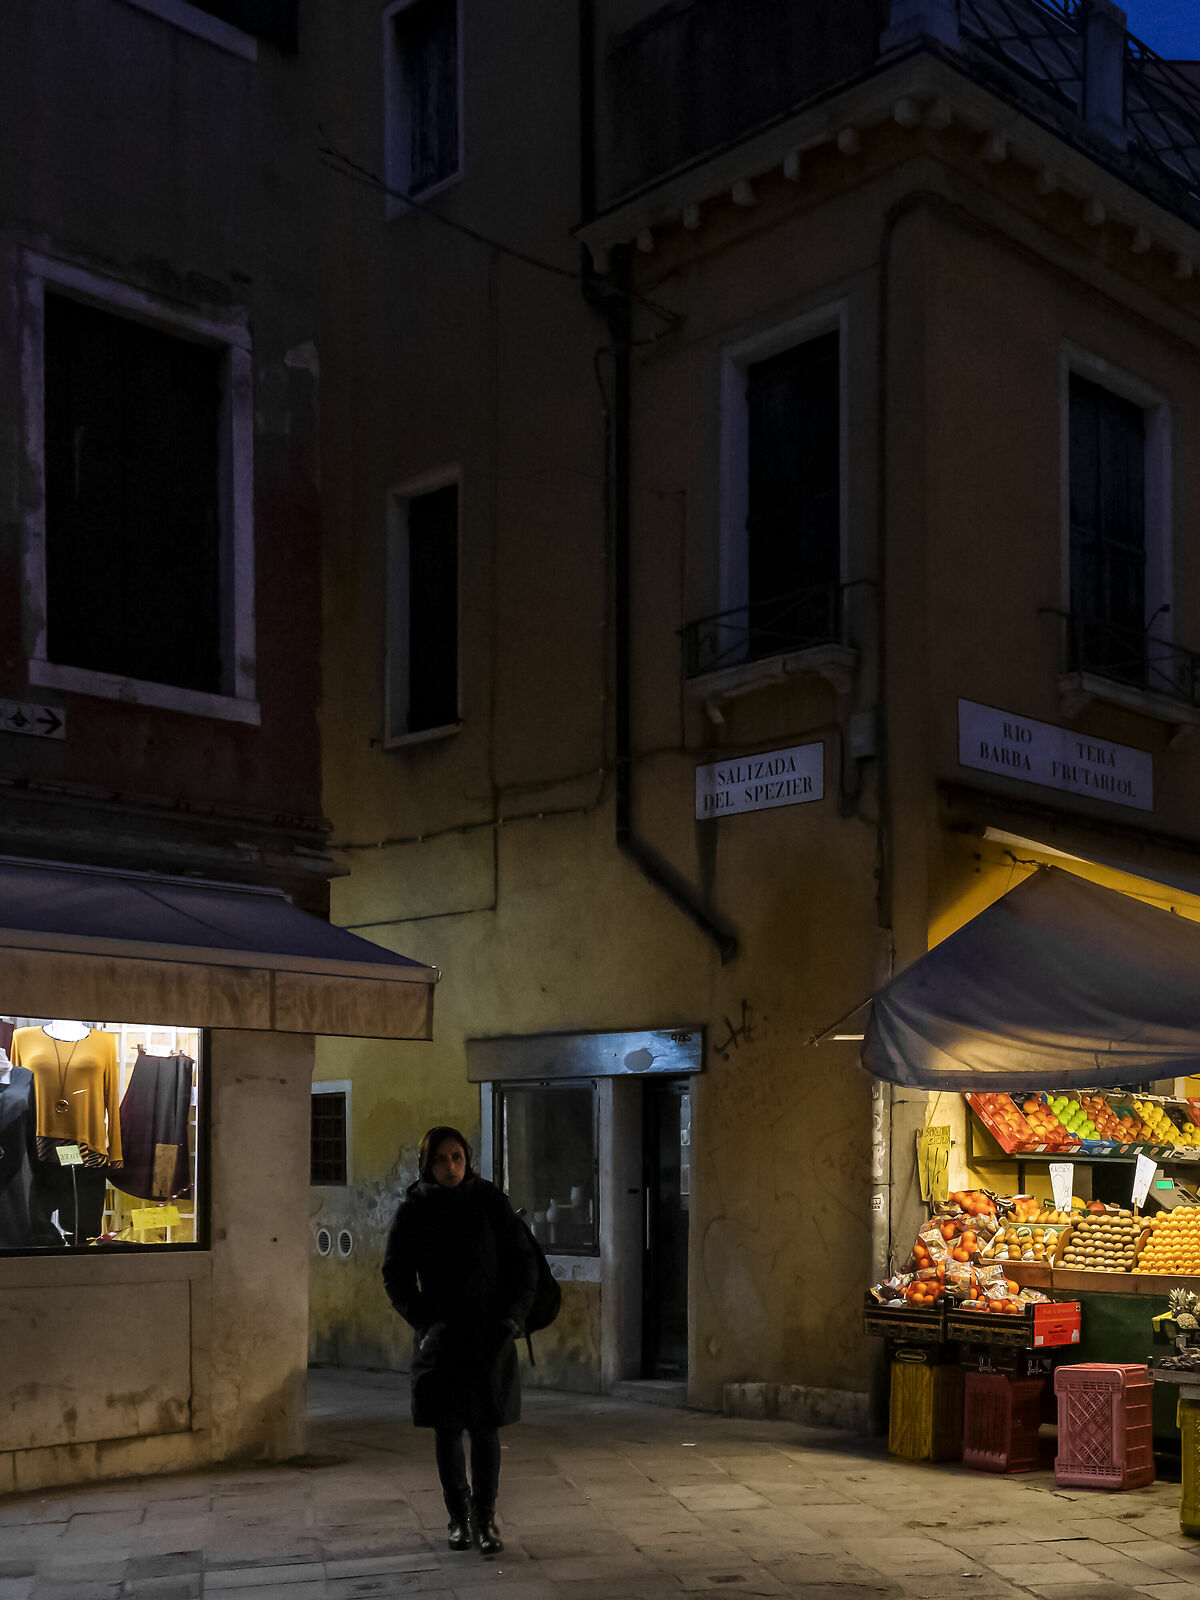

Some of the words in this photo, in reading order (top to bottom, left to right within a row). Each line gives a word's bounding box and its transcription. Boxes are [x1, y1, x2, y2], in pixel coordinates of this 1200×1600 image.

[1003, 721, 1033, 745] RIO
[717, 755, 797, 786] SALIZADA
[980, 741, 1032, 772] BARBA
[1052, 760, 1137, 798] FRUTARIOL
[704, 789, 734, 811] DEL
[744, 775, 813, 804] SPEZIER
